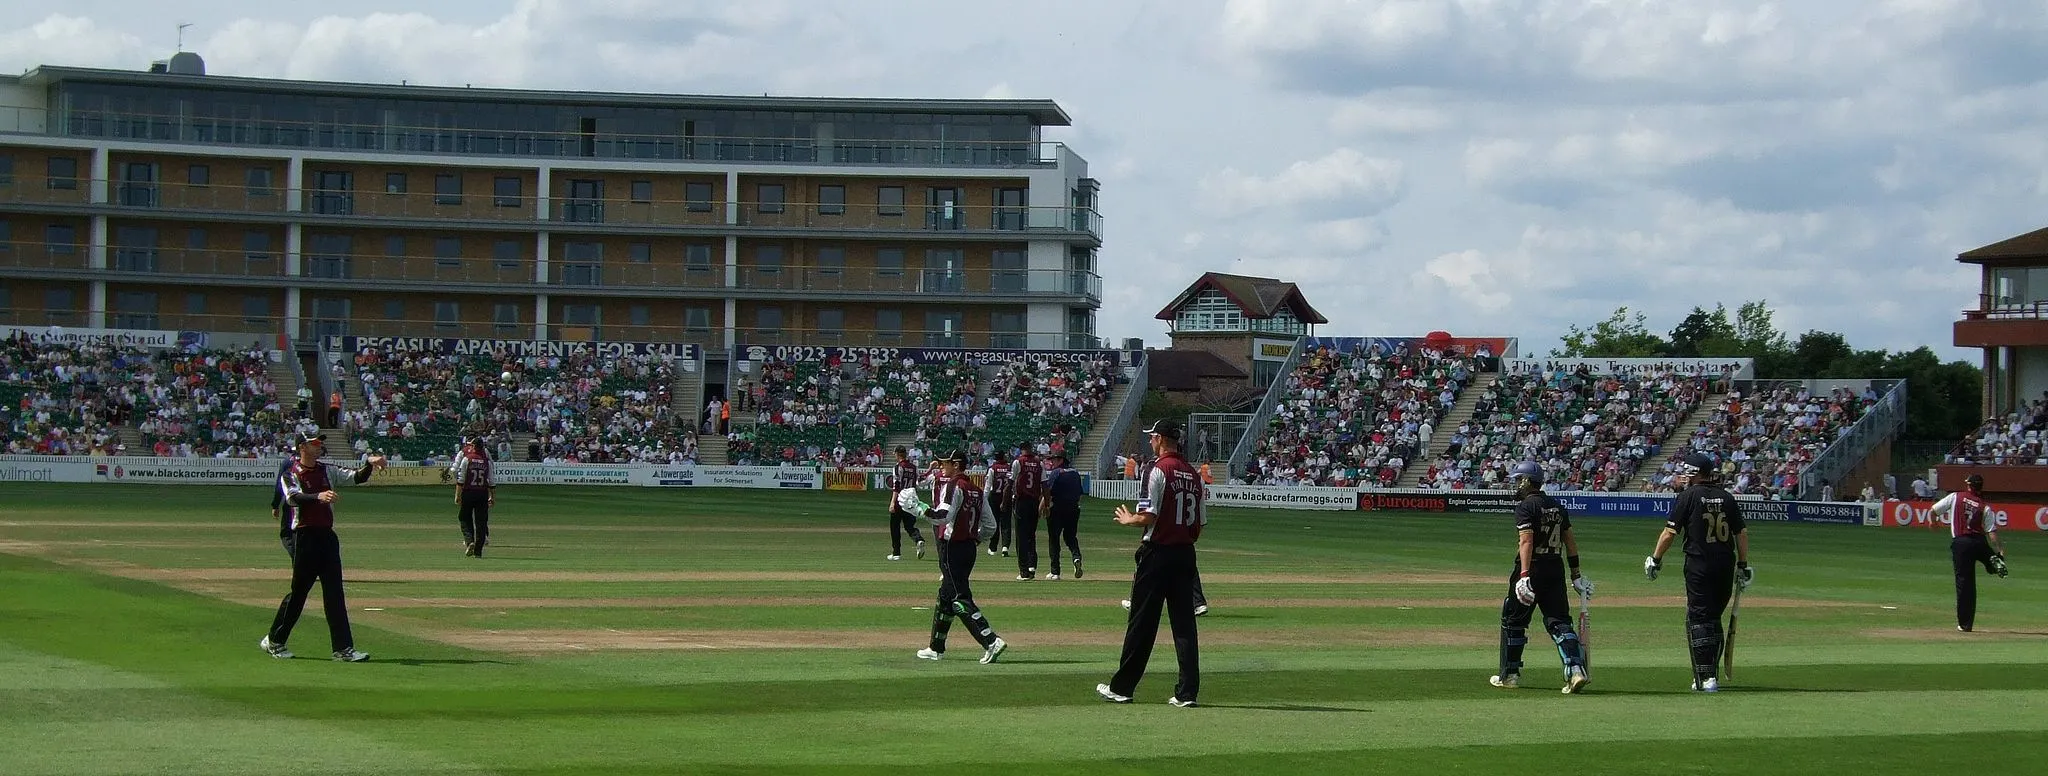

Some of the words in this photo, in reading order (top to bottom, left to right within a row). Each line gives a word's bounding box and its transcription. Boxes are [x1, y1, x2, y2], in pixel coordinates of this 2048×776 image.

[356, 337, 444, 353] PEGASUS
[128, 468, 275, 480] www.blackacrefarmeggs.com
[471, 470, 485, 486] 25
[660, 469, 694, 479] towergate
[781, 471, 814, 481] towergate
[1215, 491, 1353, 505] www.blackacrefarmeggs.com
[1377, 495, 1445, 509] Eurocams
[1560, 498, 1587, 510] Baker
[1175, 491, 1197, 526] 13
[1797, 505, 1820, 515] 0800
[1821, 506, 1837, 516] 583
[1702, 512, 1730, 543] 26
